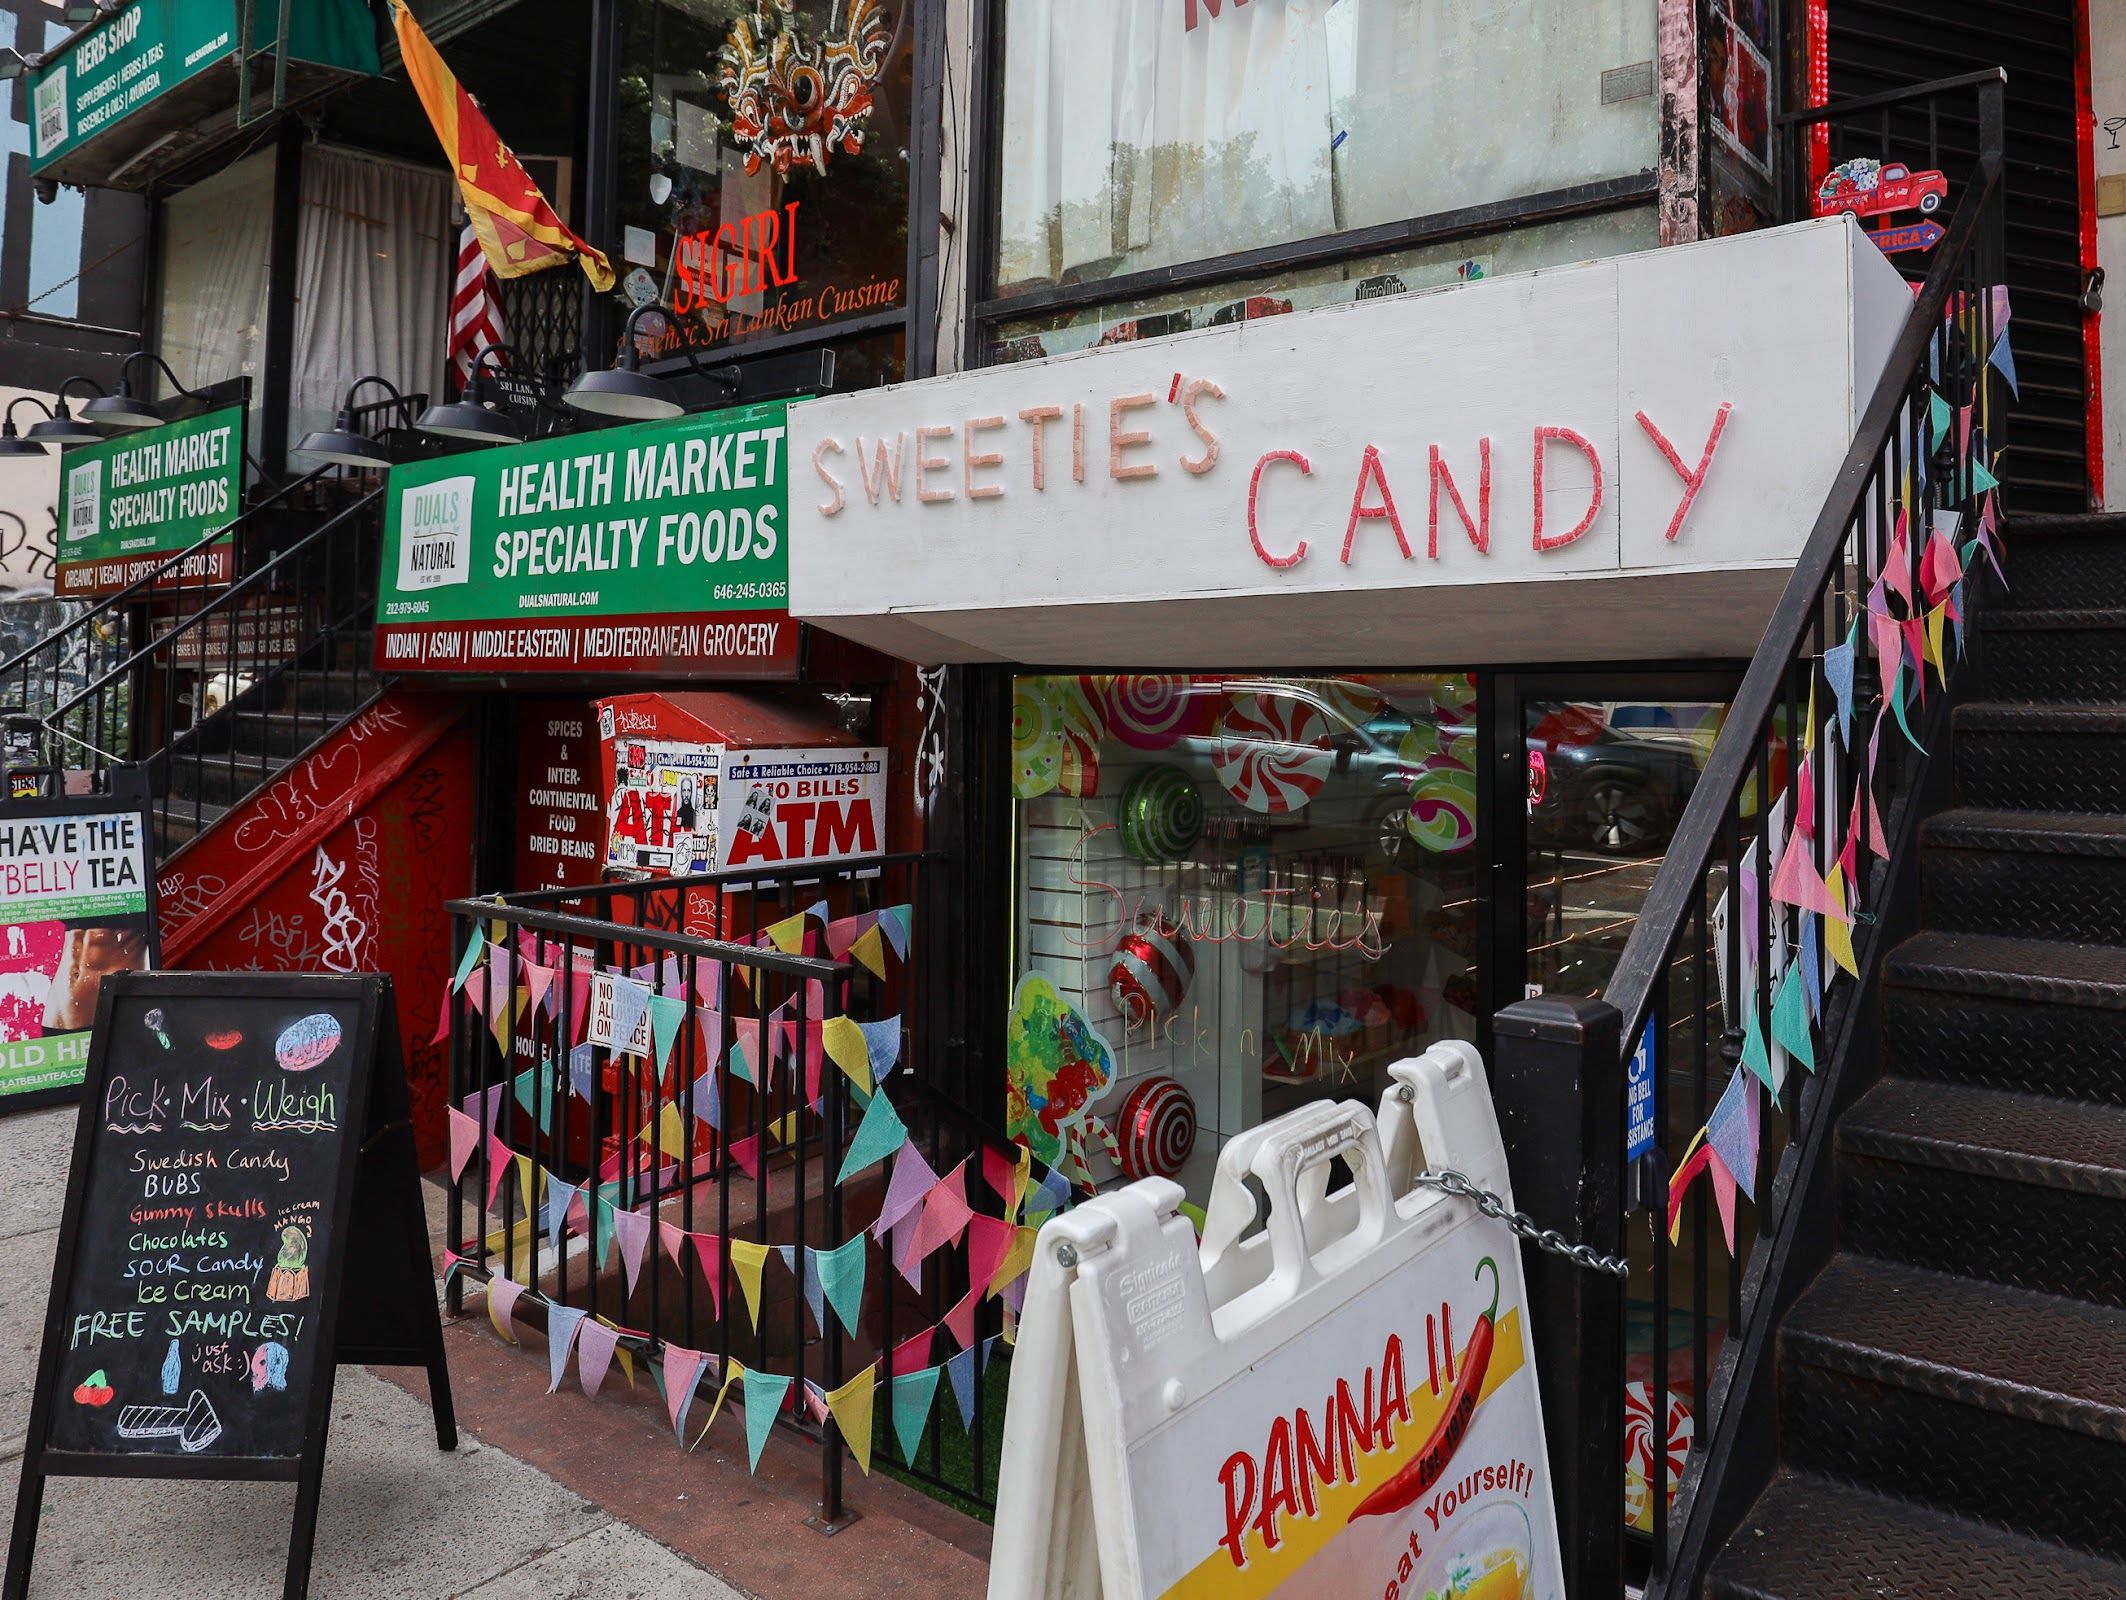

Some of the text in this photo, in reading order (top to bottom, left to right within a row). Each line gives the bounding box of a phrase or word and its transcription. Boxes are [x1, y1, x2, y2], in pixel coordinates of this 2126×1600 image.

[76, 6, 141, 77] HERB SHOP
[76, 42, 164, 113] SUPPLEMENTS HERBS & TEAS
[105, 102, 110, 117] &
[128, 71, 160, 104] AYURVEDA
[673, 200, 800, 316] SIGIRI
[735, 291, 813, 337] Lankan
[817, 275, 899, 321] Cuisine
[111, 426, 231, 489] HEALTH MARKET
[811, 372, 1227, 518] SWEETIE'S
[498, 425, 786, 517] HEALTH MARKET
[1246, 401, 1735, 569] CANDY
[109, 476, 228, 530] SPECIALTY FOODS
[414, 490, 460, 527] DUALS
[492, 503, 780, 579] SPECIALTY FOODS
[410, 540, 456, 573] NATURAL
[64, 566, 94, 589] ORGANIC
[99, 563, 123, 585] VEGAN
[518, 591, 599, 609] DUALSNATURAL.COM
[713, 581, 787, 600] 646-245-0365
[386, 600, 430, 615] 212-979-6045
[385, 622, 780, 659] INDIAN ASIAN MIDDLE EASTERN MEDITERRANEAN GROCERY
[547, 720, 583, 739] SPICES
[560, 745, 569, 761] &
[547, 767, 581, 786] INTER-
[731, 762, 878, 779] Safe & Reliable Choice 718-954-2488
[529, 788, 599, 811] CONTINENTAL
[797, 778, 860, 798] BILLS
[548, 814, 577, 832] FOOD
[726, 799, 878, 866] ATM
[0, 819, 136, 857] HAVE THE
[529, 834, 559, 854] DRIED
[561, 839, 595, 860] BEANS
[87, 856, 137, 888] TEA
[557, 862, 566, 879] &
[599, 982, 613, 1000] NO
[596, 1019, 611, 1037] ON
[515, 1036, 547, 1062] HOUE
[1291, 1024, 1358, 1086] Mix
[1638, 1078, 1652, 1101] BELL
[181, 1076, 232, 1120] Mix
[253, 1078, 337, 1134] Weigh
[1632, 1102, 1644, 1125] FOR
[129, 1148, 290, 1182] Swedish Candy
[144, 1172, 201, 1198] BUBS
[130, 1204, 194, 1228] Gummy
[291, 1200, 320, 1212] cream
[273, 1215, 313, 1232] MANGO
[128, 1229, 229, 1252] Chocolates
[123, 1252, 265, 1284] SOUR Candy
[137, 1279, 251, 1305] Ice Cream
[70, 1310, 305, 1350] FREE SAMPLES!
[202, 1355, 233, 1374] ask
[1218, 1333, 1414, 1570] PANNA
[1424, 1458, 1534, 1533] Yourself!
